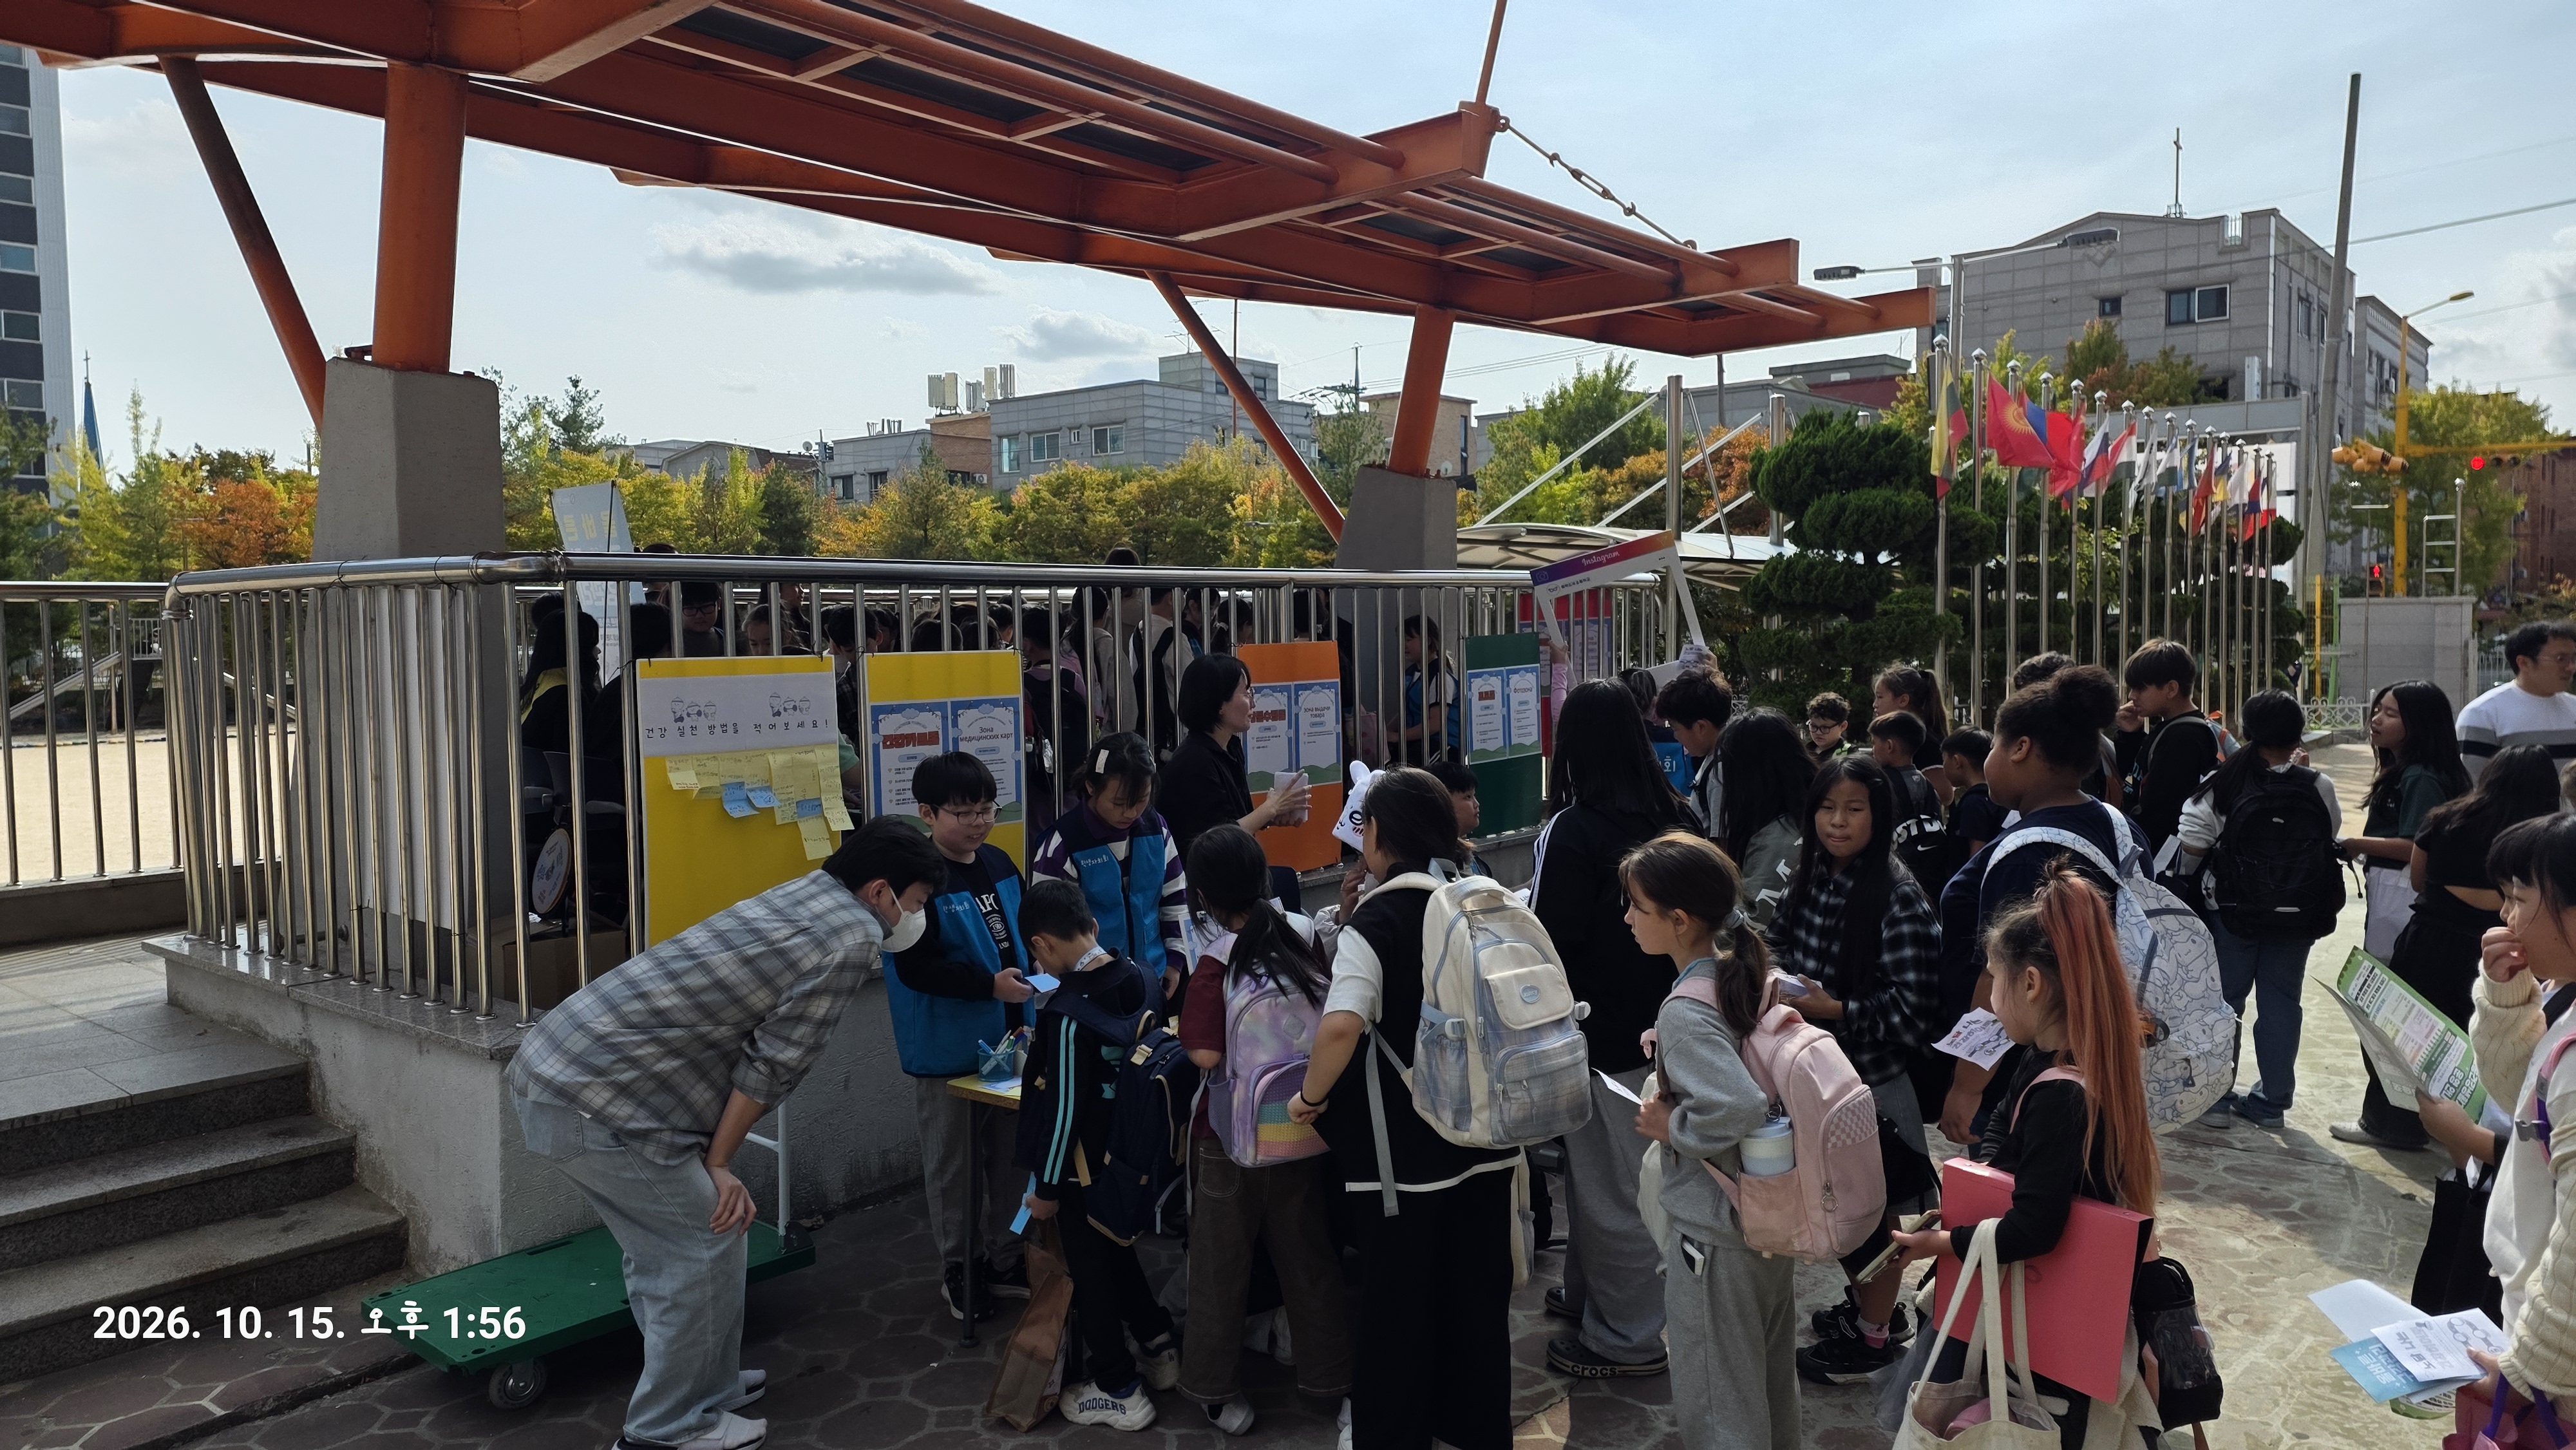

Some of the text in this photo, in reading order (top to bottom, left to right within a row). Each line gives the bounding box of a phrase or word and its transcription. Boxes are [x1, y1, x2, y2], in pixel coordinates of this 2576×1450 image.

[1582, 551, 1620, 567] Instagram
[645, 727, 667, 739] 건강
[677, 725, 697, 737] 실천
[708, 722, 739, 735] 방법을
[960, 734, 999, 743] медицинских
[1081, 854, 1109, 867] 학생자치회
[2456, 1064, 2478, 1108] 건강생활
[1571, 1364, 1617, 1377] crocs
[2357, 1351, 2398, 1385] 올바른
[1078, 1397, 1126, 1415] DODGERS
